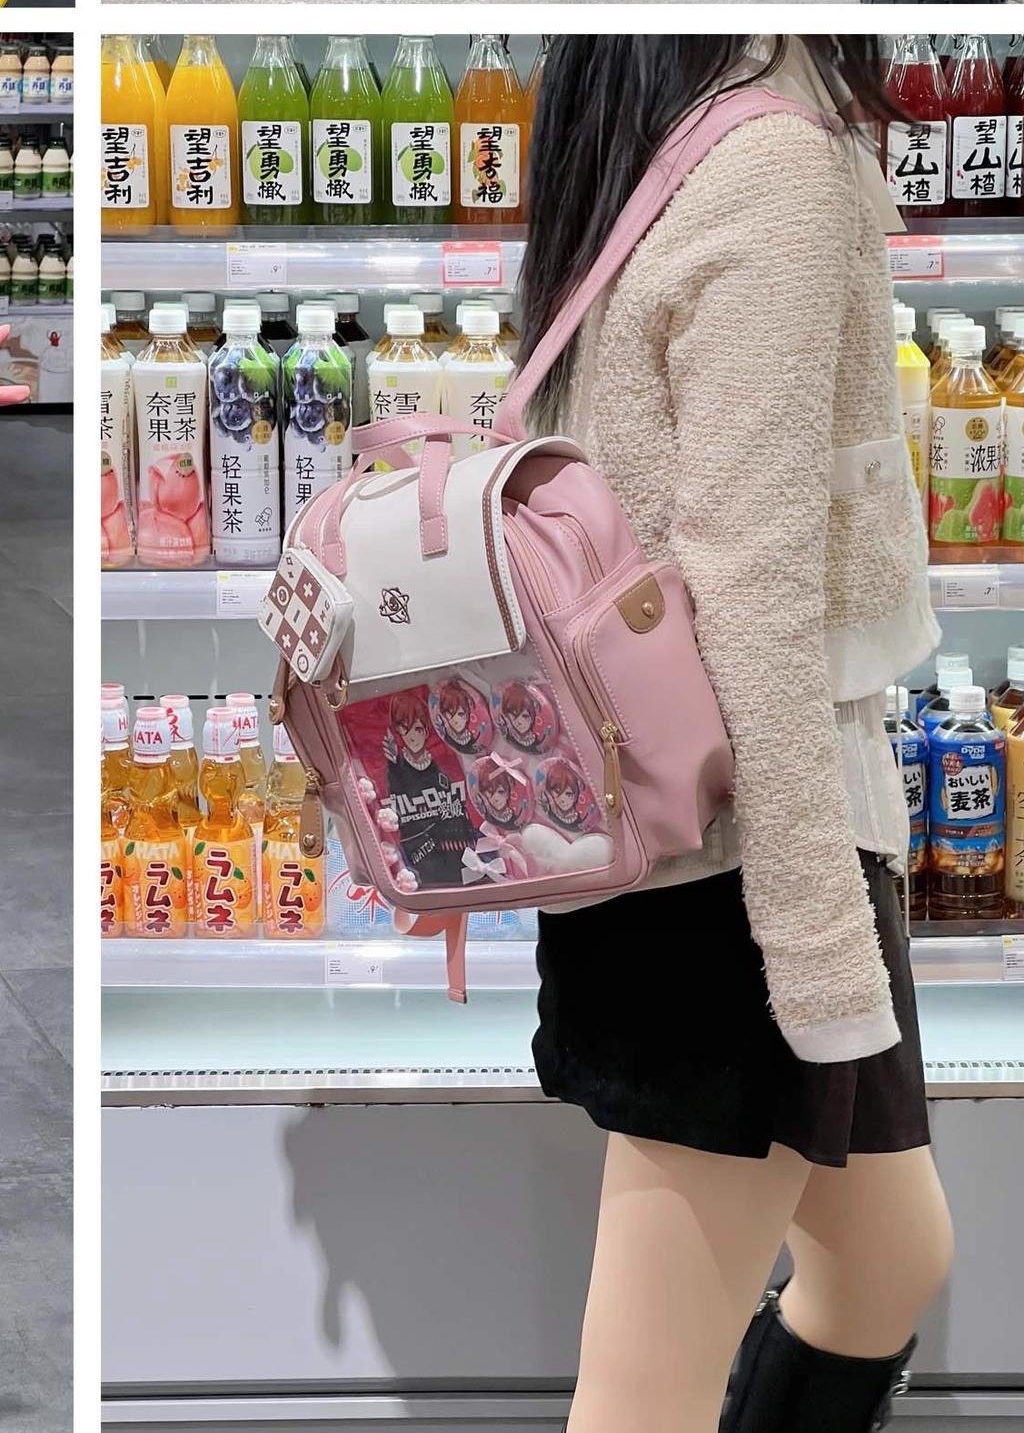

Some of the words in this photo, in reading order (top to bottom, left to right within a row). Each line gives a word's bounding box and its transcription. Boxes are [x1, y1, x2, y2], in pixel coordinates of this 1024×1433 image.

[102, 127, 132, 205] 望吉利
[184, 127, 214, 205] 望吉利
[895, 124, 939, 203] 望山楂
[962, 118, 1002, 196] 望山楂
[146, 391, 197, 417] 奈雪
[147, 418, 197, 443] 果茶
[295, 455, 315, 515] 轻果
[970, 444, 1001, 473] 浓果
[221, 454, 243, 534] 轻果茶
[380, 780, 466, 816] ブルーロック
[947, 773, 990, 788] おいしい
[950, 788, 991, 813] 麦茶
[145, 862, 172, 933] ラムネ
[206, 850, 235, 932] ラムネ
[278, 863, 304, 933] ラムネ
